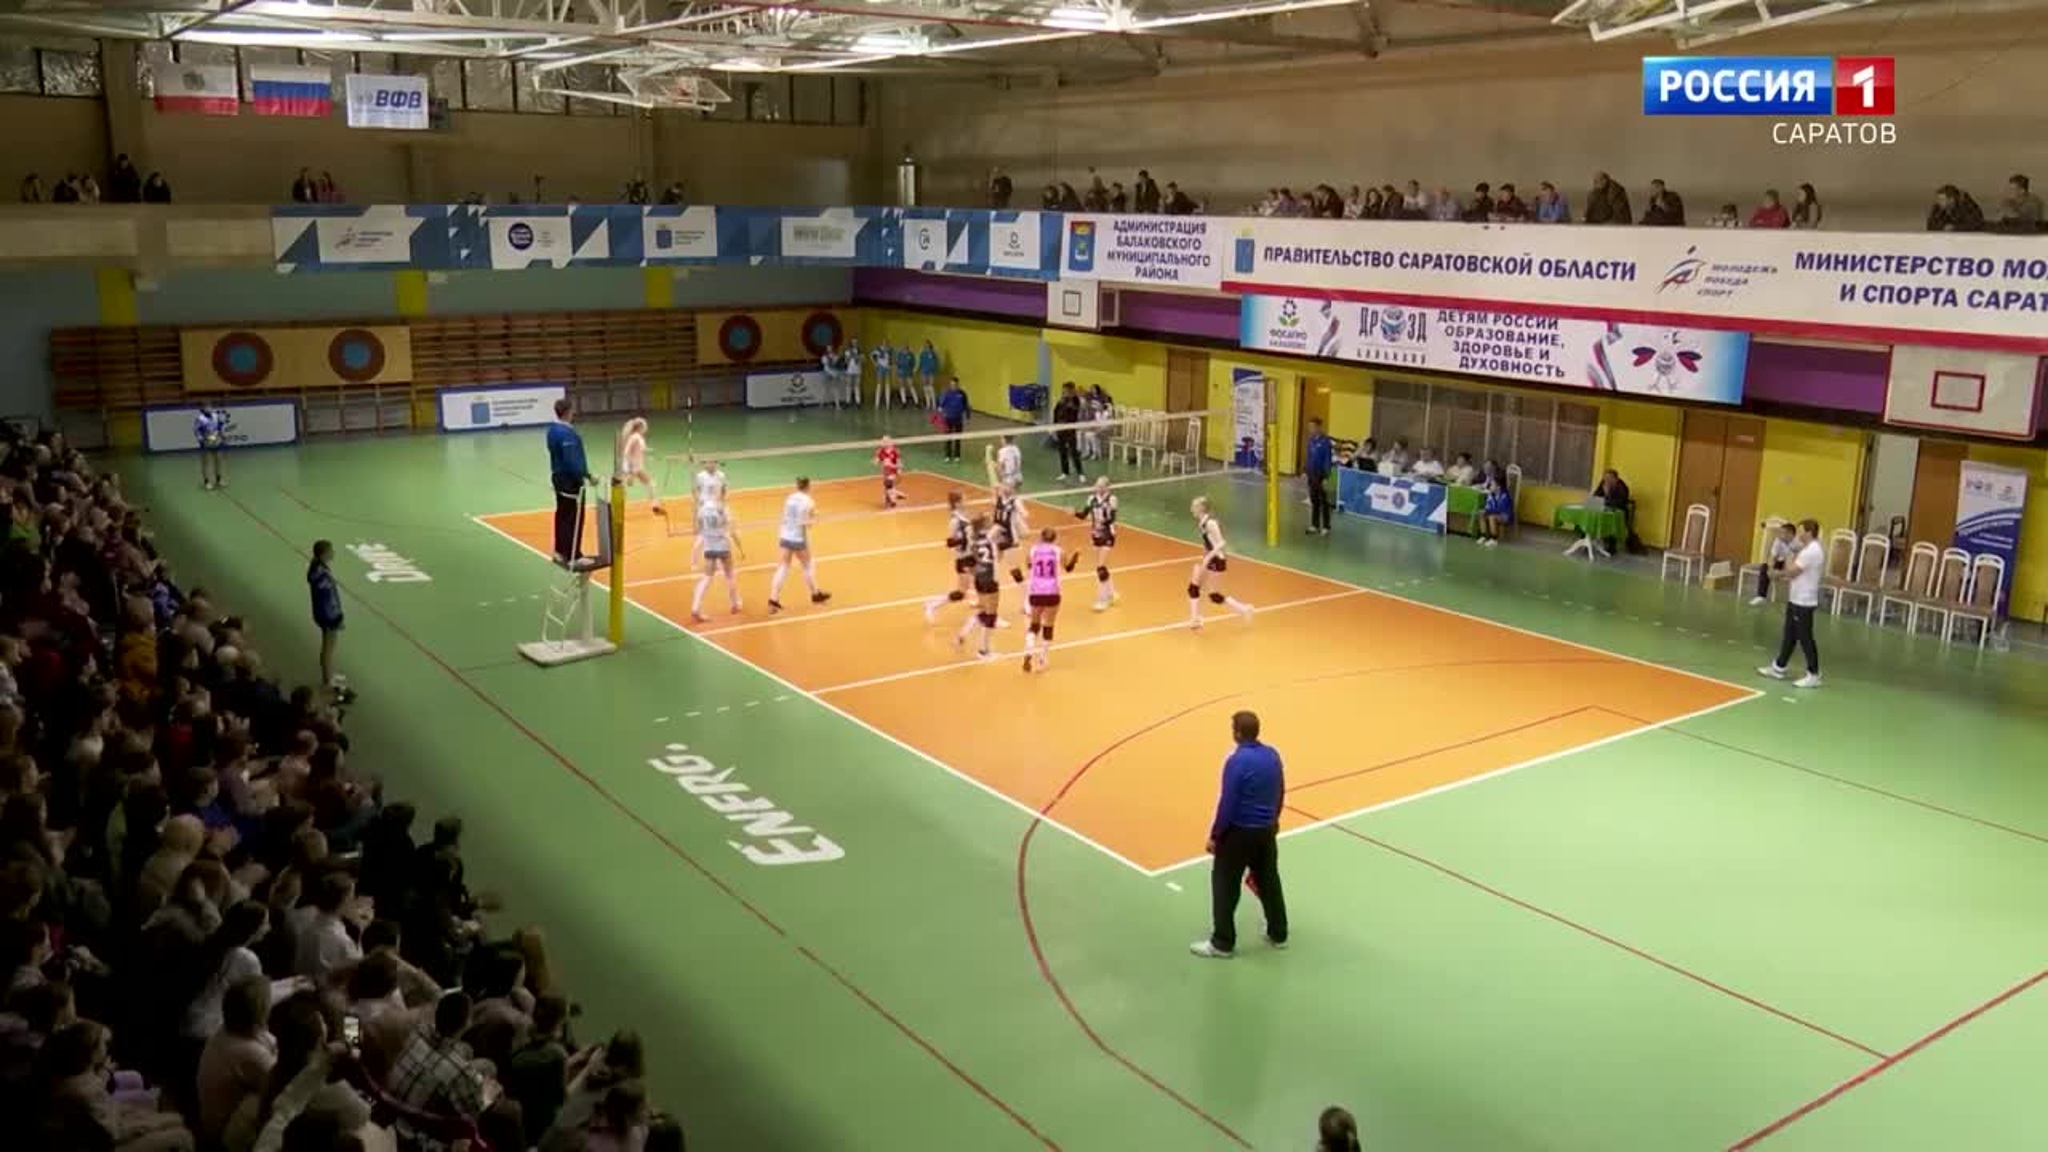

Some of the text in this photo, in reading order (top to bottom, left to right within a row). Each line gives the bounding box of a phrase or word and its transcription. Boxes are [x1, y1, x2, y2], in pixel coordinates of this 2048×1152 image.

[375, 89, 422, 109] ВФВ
[1113, 219, 1207, 235] АДМИНИСТРАЦИЯ
[1116, 235, 1202, 251] БАЛАКОВСКОГО
[1107, 250, 1211, 267] МУНИЦИПАЛЬНОГО
[1263, 246, 1637, 287] ПРАВИТЕЛЬСТВО САРАТОВСКОЙ ОБЛАСТИ
[1794, 251, 2048, 280] МИНИСТЕРСТВО МО
[1135, 263, 1179, 280] РАЙОНА
[1840, 283, 1856, 303] И
[1863, 284, 1959, 308] СПОРТА
[1437, 309, 1559, 330] ДЕТЯМ РОССИИ
[1444, 325, 1565, 349] ОБРАЗОВАНИЕ,
[1453, 340, 1550, 361] ЗДОРОВЬЕ И
[1458, 355, 1565, 378] ДУХОВНОСТЬ
[1035, 559, 1055, 577] 11
